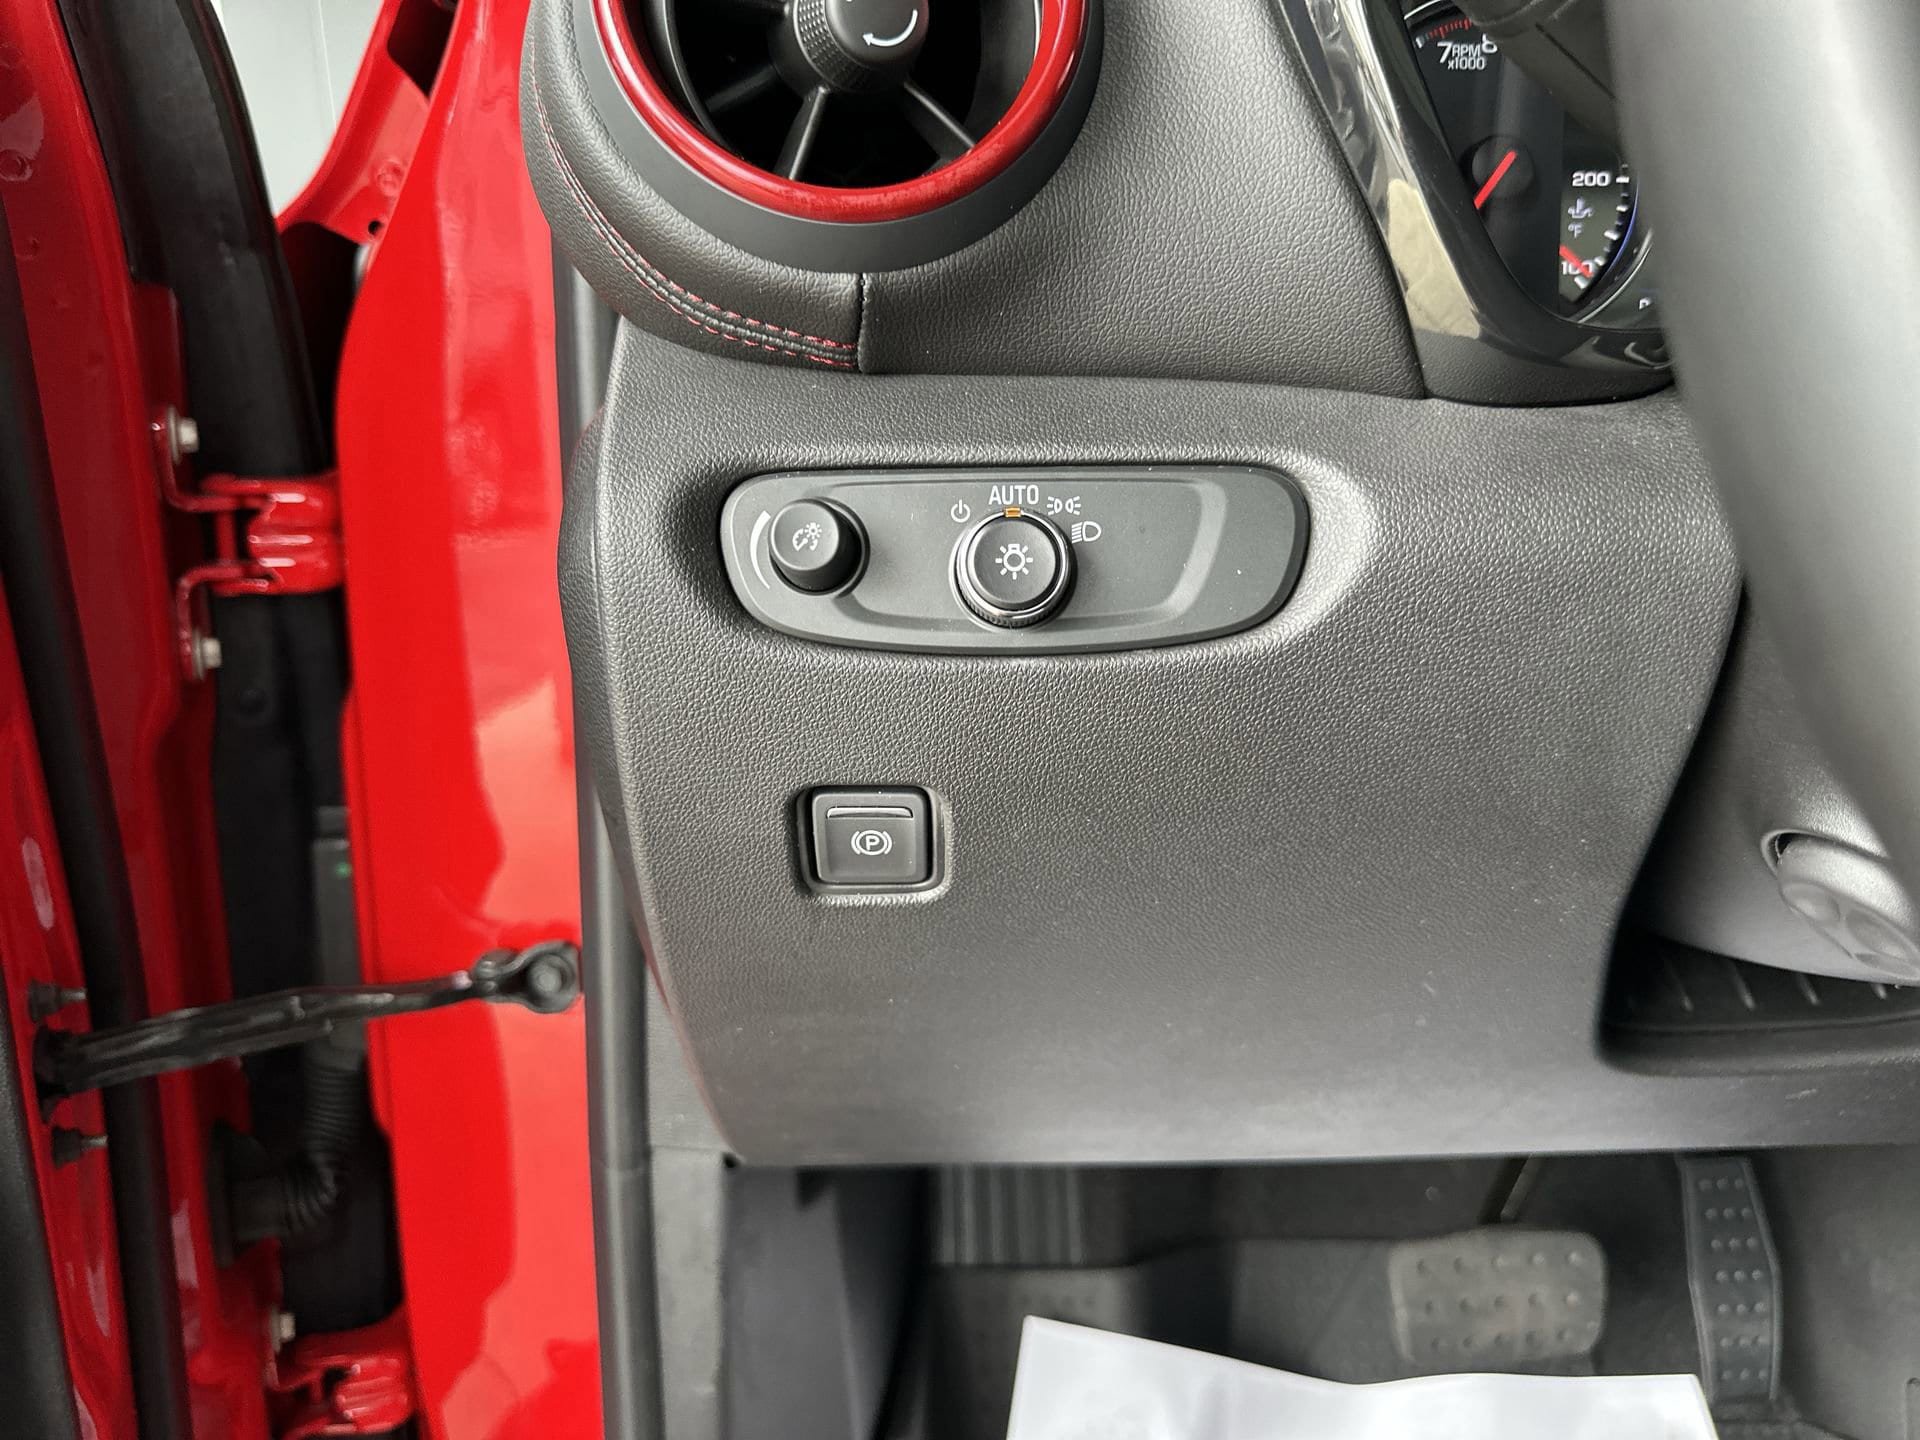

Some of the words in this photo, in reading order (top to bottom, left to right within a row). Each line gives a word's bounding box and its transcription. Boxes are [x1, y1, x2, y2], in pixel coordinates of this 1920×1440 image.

[1437, 41, 1453, 63] 7
[1452, 43, 1481, 57] RPM
[1447, 57, 1486, 70] x1000
[1572, 171, 1611, 187] 200
[988, 484, 1039, 505] AUTO
